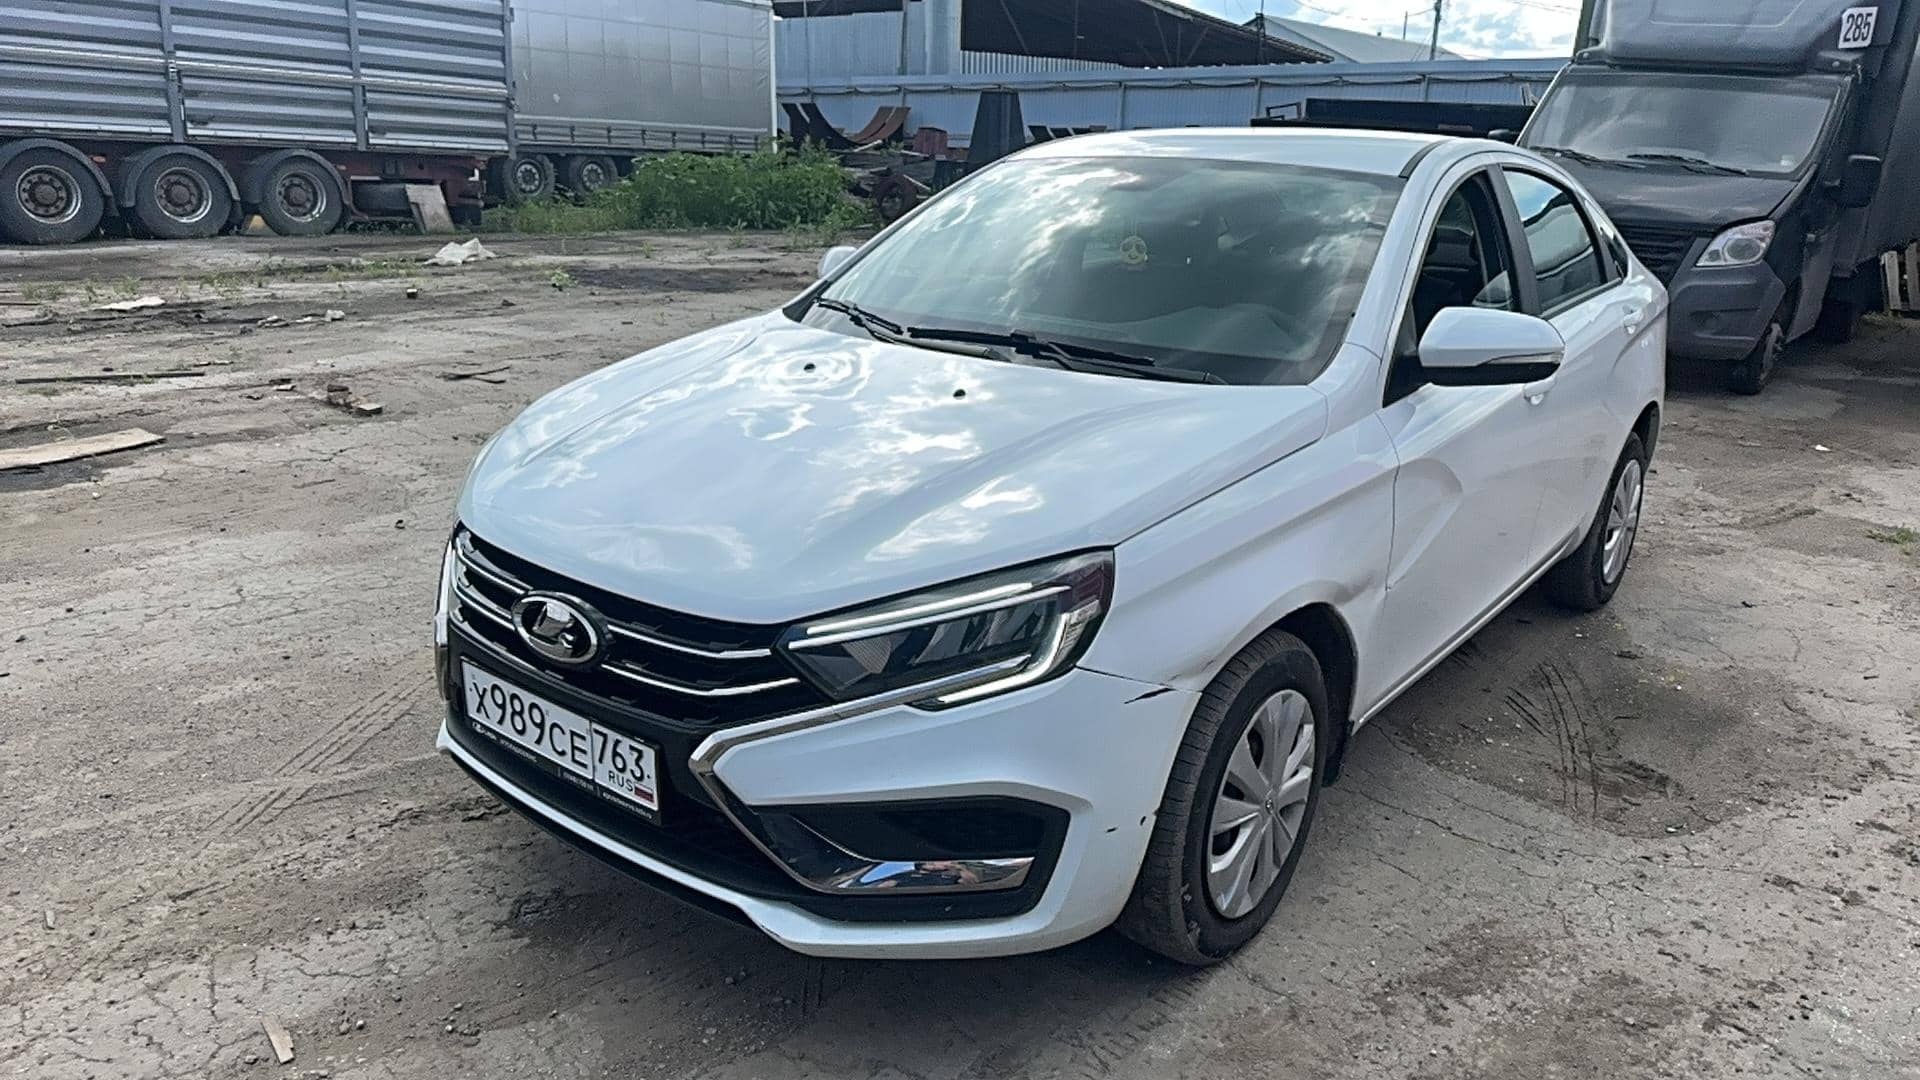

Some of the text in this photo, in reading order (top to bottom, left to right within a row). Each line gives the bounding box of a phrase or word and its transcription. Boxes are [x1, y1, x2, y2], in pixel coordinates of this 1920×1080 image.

[1843, 12, 1873, 42] 285
[593, 728, 645, 782] 763
[608, 770, 634, 793] RUS
